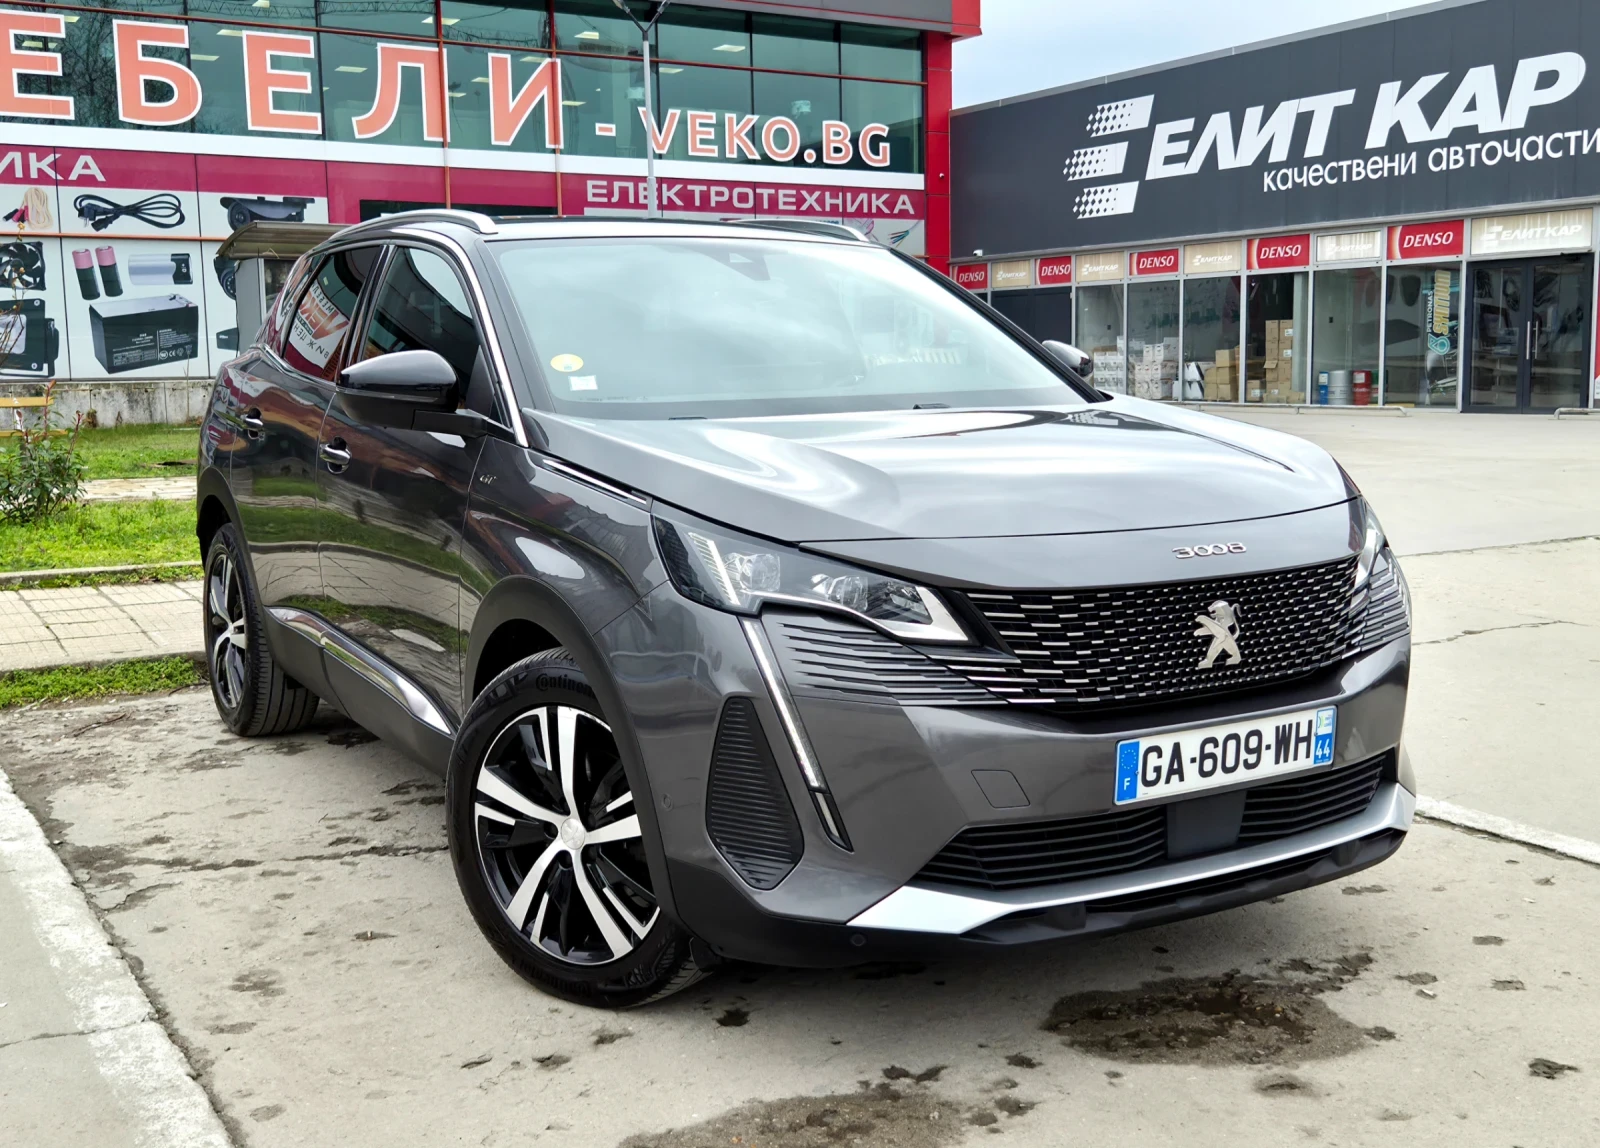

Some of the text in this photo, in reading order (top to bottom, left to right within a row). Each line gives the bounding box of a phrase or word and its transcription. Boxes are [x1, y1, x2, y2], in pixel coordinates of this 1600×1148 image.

[1145, 51, 1587, 181] ЕЛИТ КАР
[637, 106, 891, 167] VEKO.BG
[1263, 126, 1600, 193] качествени авточасти
[586, 179, 915, 215] ЕЛЕКТРОТЕХНИКА
[1402, 231, 1454, 248] DENSO
[1260, 244, 1302, 260] DENSO
[1041, 264, 1071, 277] DENSO
[1139, 255, 1175, 269] DENSO
[958, 271, 985, 283] DENSO
[1426, 290, 1434, 333] PETRONAS
[1172, 541, 1247, 559] 3008
[1141, 719, 1313, 788] GA-609-WH
[1315, 738, 1331, 759] 44
[1123, 777, 1131, 791] F
